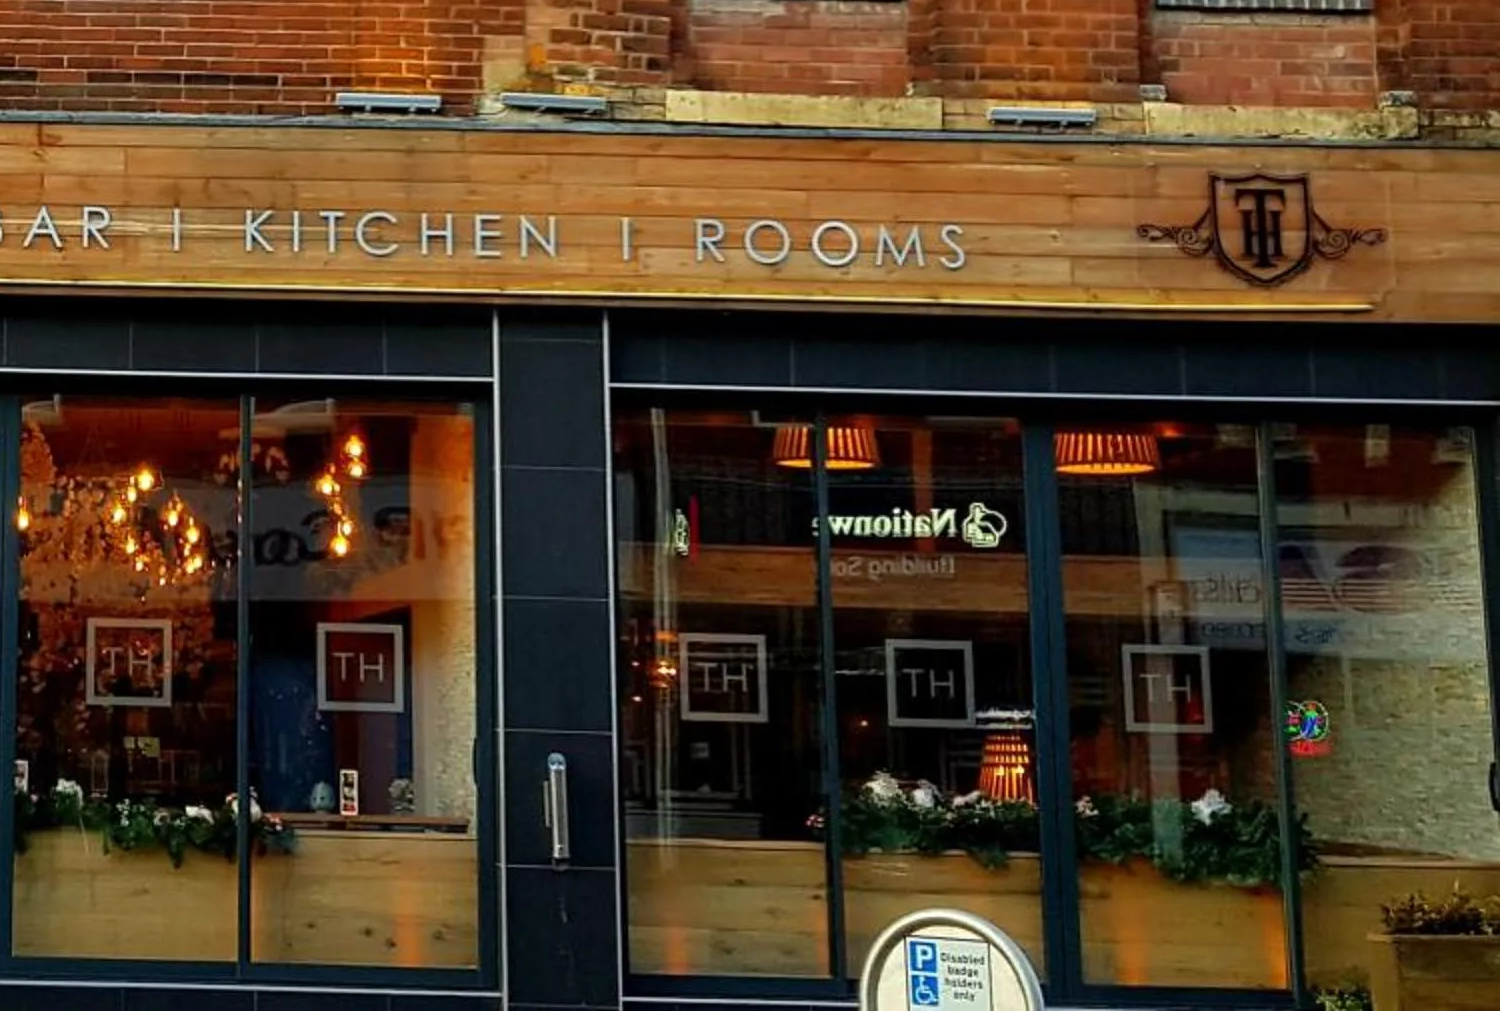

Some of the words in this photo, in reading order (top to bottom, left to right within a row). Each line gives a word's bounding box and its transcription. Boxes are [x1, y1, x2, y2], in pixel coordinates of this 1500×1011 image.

[245, 209, 558, 259] KITCHEN
[693, 218, 967, 269] ROOMS
[104, 646, 153, 676] TH
[332, 651, 385, 683] TH
[699, 662, 749, 692] TH
[904, 667, 956, 699] TH
[1139, 672, 1191, 702] TH
[940, 952, 985, 966] Disabled
[947, 965, 979, 977] badge
